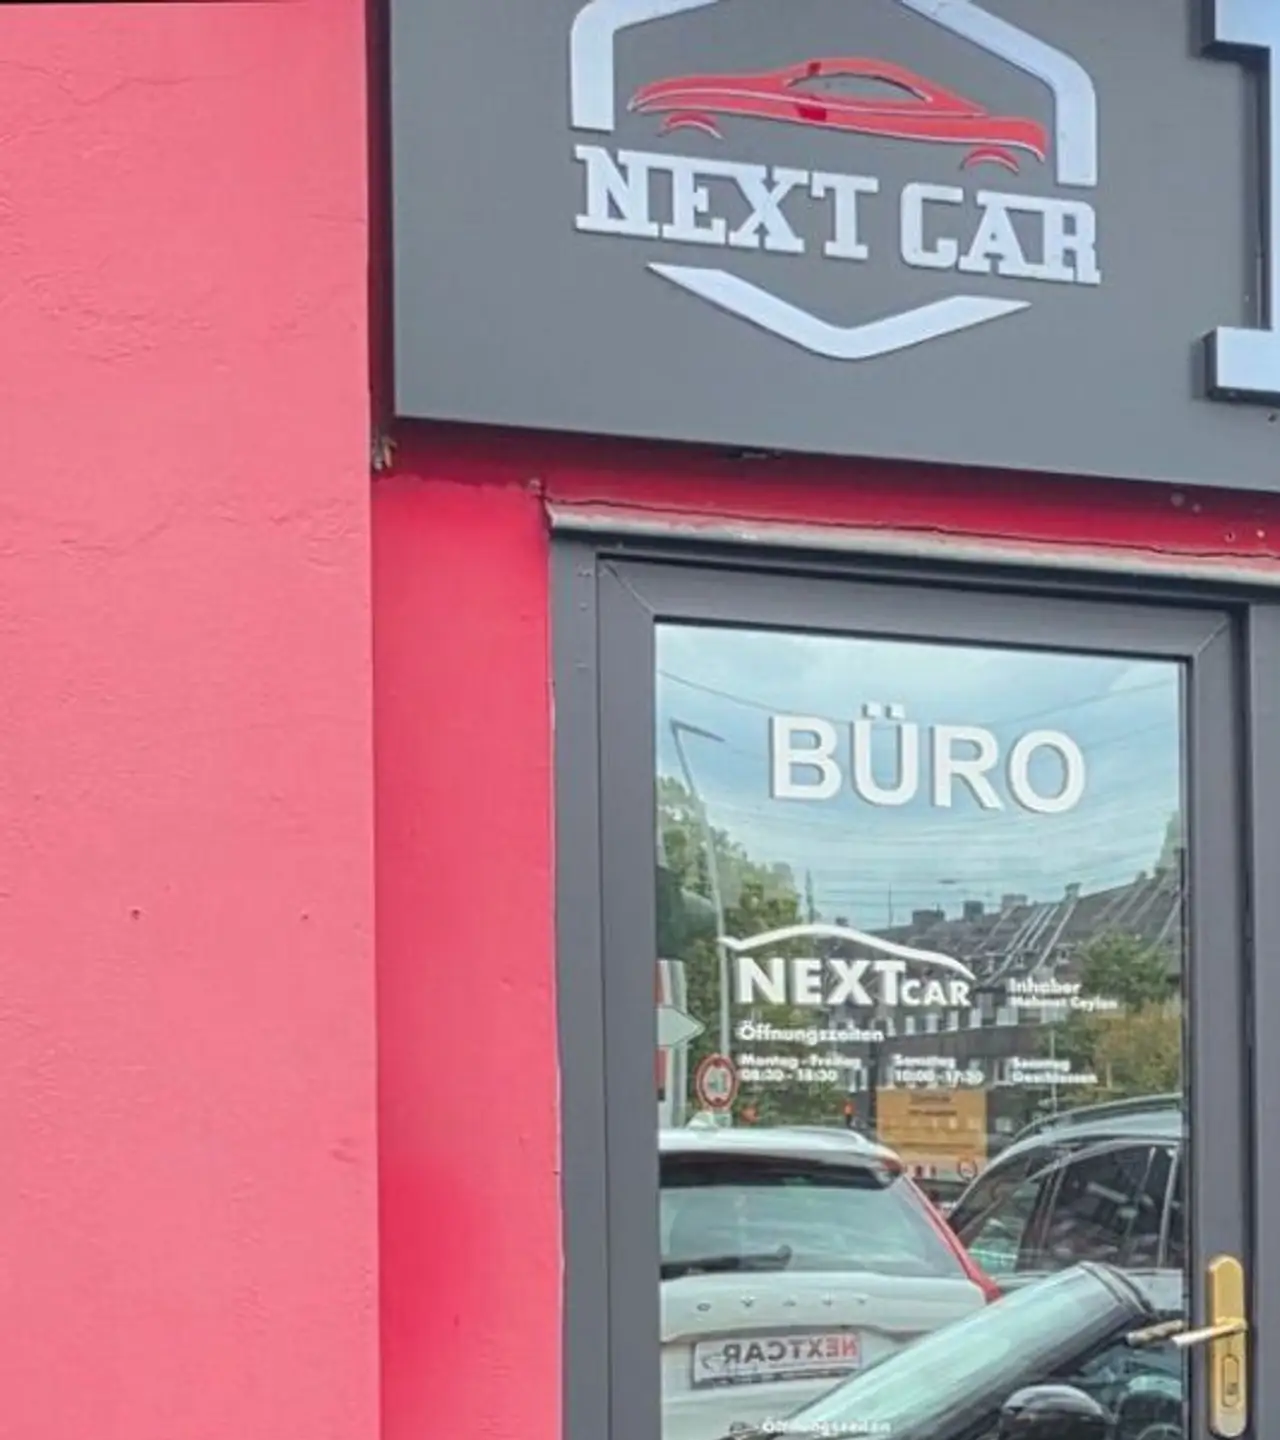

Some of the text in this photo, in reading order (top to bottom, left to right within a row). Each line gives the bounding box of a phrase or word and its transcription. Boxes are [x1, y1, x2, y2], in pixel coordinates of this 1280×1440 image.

[574, 144, 1101, 285] NEXT CAR
[769, 702, 1085, 814] BÜRO
[1008, 976, 1082, 995] Inhaber
[737, 1020, 884, 1045] Öffnungszeiten
[739, 1053, 798, 1069] Montag
